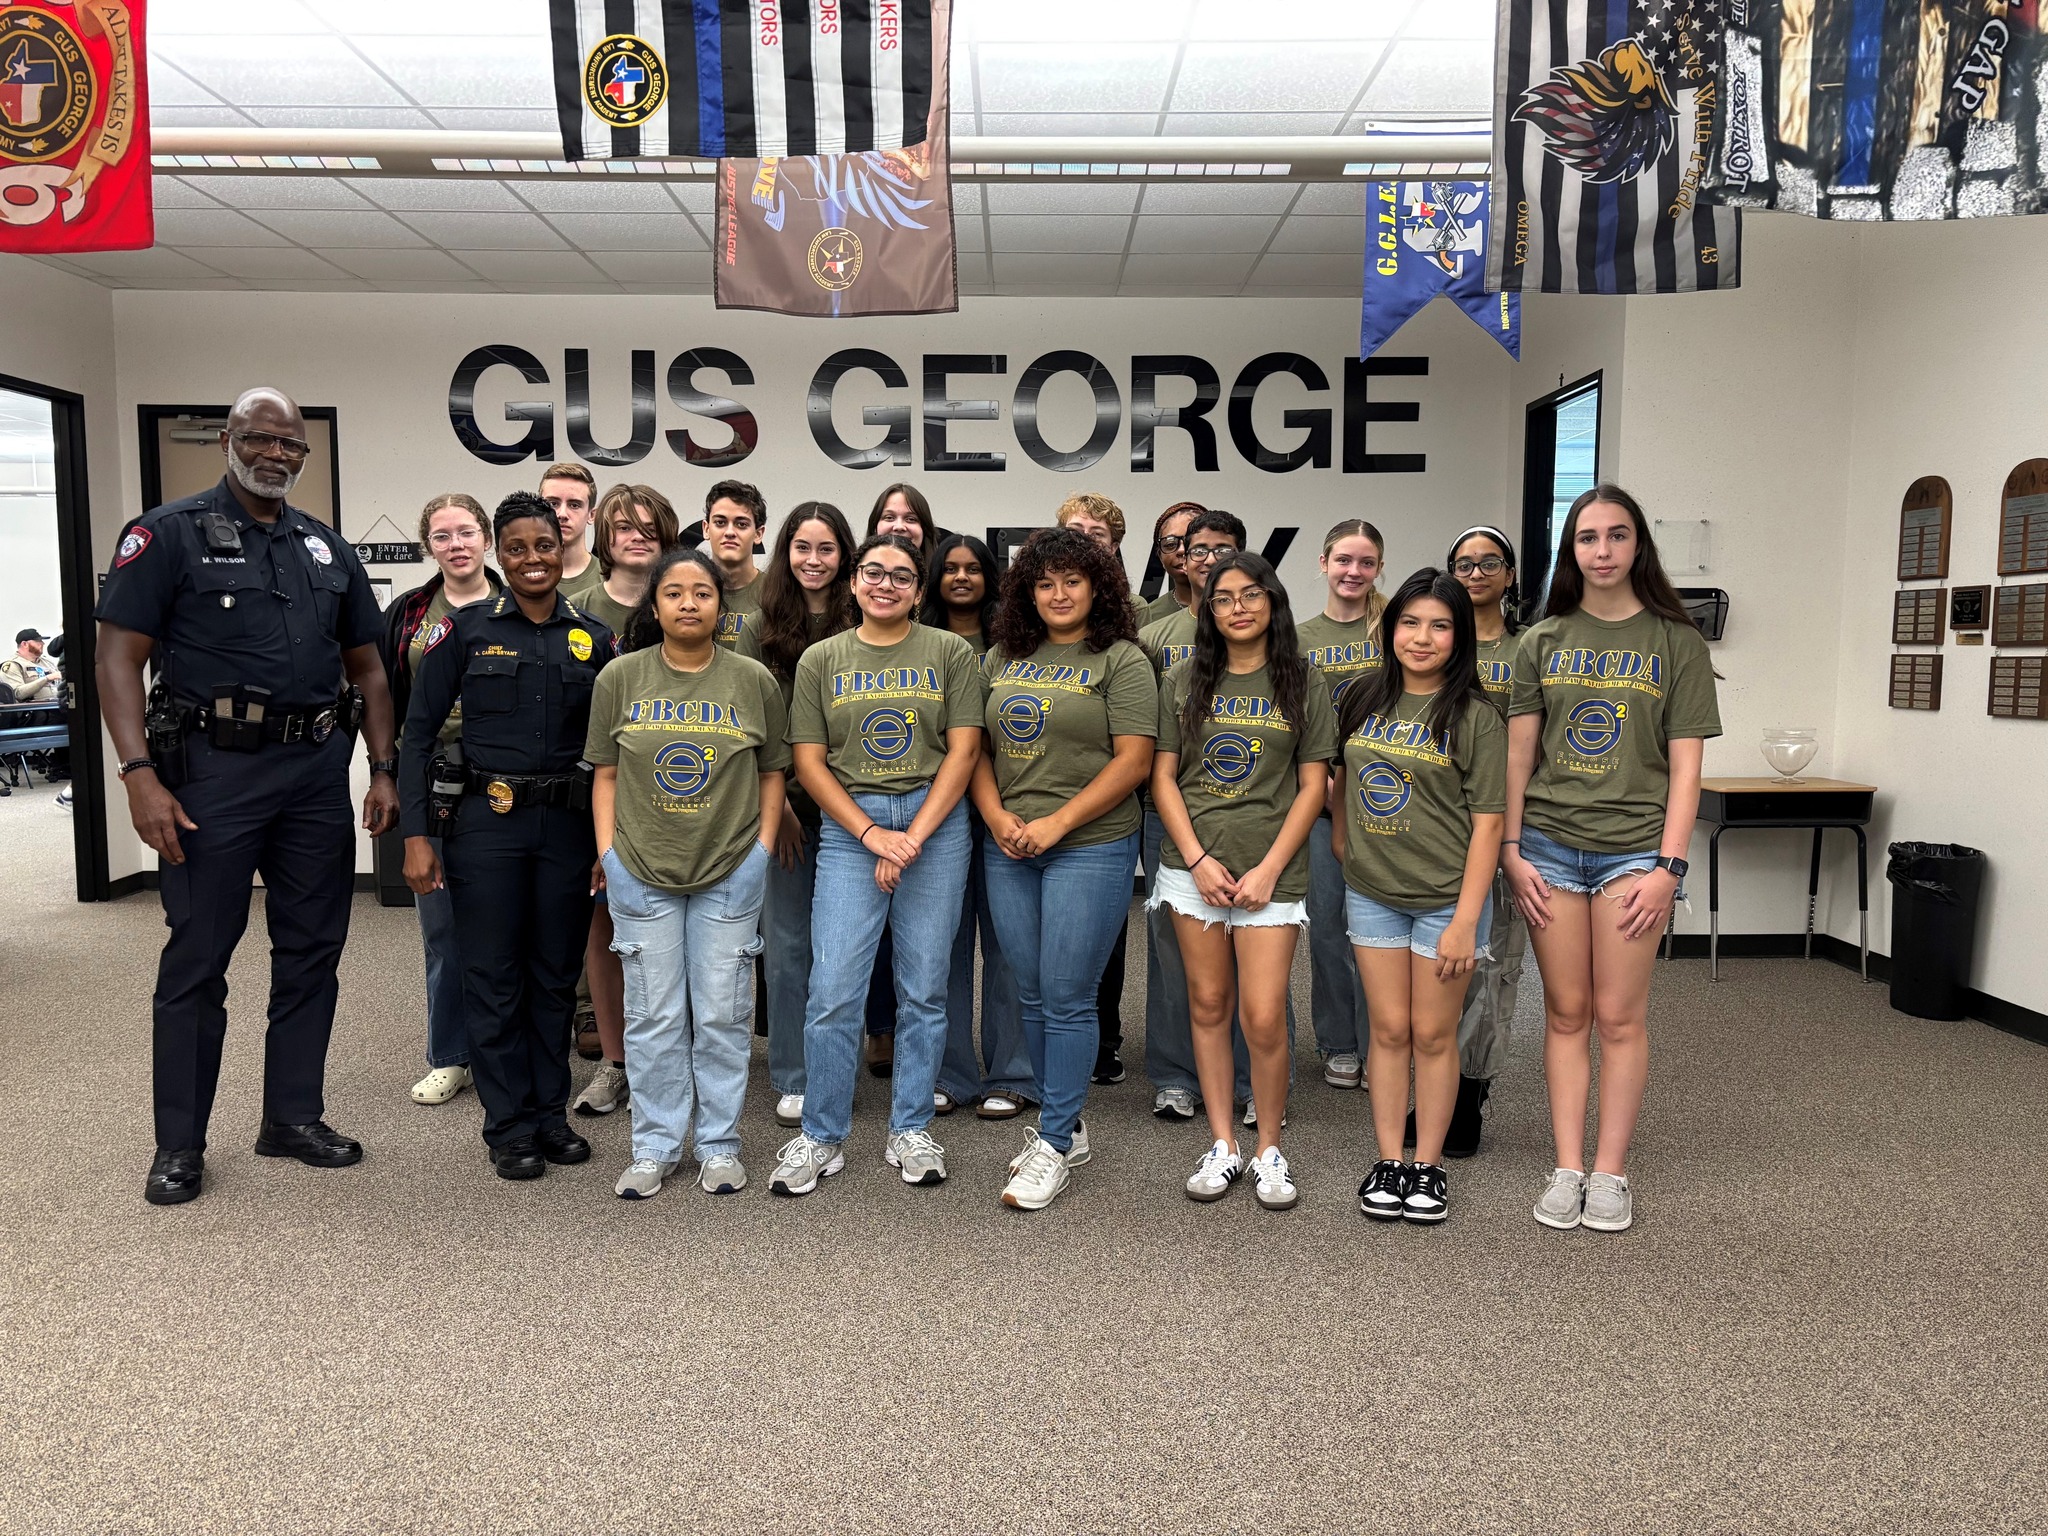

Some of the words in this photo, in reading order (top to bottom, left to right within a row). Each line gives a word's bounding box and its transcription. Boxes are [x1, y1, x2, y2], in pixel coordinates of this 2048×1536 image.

[880, 0, 898, 50] KERS
[54, 31, 79, 63] GUS
[602, 43, 615, 54] LAW
[641, 50, 657, 70] GUS
[1676, 13, 1704, 80] Serve
[588, 51, 603, 99] ENFORCEMENT
[1952, 19, 2009, 110] GAP
[57, 70, 88, 138] GEORGE
[109, 64, 127, 131] TAKES
[642, 72, 661, 112] GEORGE
[593, 100, 618, 119] ACADEMY
[1693, 81, 1716, 144] With
[100, 133, 119, 153] IS
[1725, 63, 1753, 194] FOXTROT
[1668, 150, 1707, 219] Pride
[726, 215, 738, 266] LEAGUE
[1514, 201, 1529, 267] OMEGA
[810, 236, 822, 272] ENFORCEMENT
[1701, 246, 1719, 264] 43
[814, 272, 834, 288] ACADEMY
[449, 344, 758, 469] GUS
[807, 347, 1428, 474] GEORGE
[214, 556, 246, 564] WILSON
[394, 552, 412, 560] dare
[1308, 640, 1384, 666] FBCD
[1547, 648, 1662, 687] FBCDA
[833, 667, 941, 698] FBCDA
[997, 660, 1091, 686] FBCDA
[1563, 676, 1580, 684] LAW
[1581, 678, 1631, 689] ENFORCEMENT
[1631, 681, 1662, 699] ACADEMY
[849, 693, 863, 701] LAW
[865, 691, 915, 699] ENFORCEMENT
[916, 691, 945, 703] ACADEM
[1060, 684, 1091, 696] ACADEMY
[630, 699, 743, 730] FBCDA
[1211, 694, 1292, 724] BCDA
[663, 723, 717, 733] ENFORCEMENT
[718, 727, 748, 741] ACADEMY
[1359, 713, 1450, 757] BCDA
[861, 765, 917, 773] EXCELLENCE
[1367, 741, 1417, 757] ENFORCEMENT
[1417, 752, 1452, 767] ACADEMY
[1557, 759, 1618, 770] EXCELLENCE
